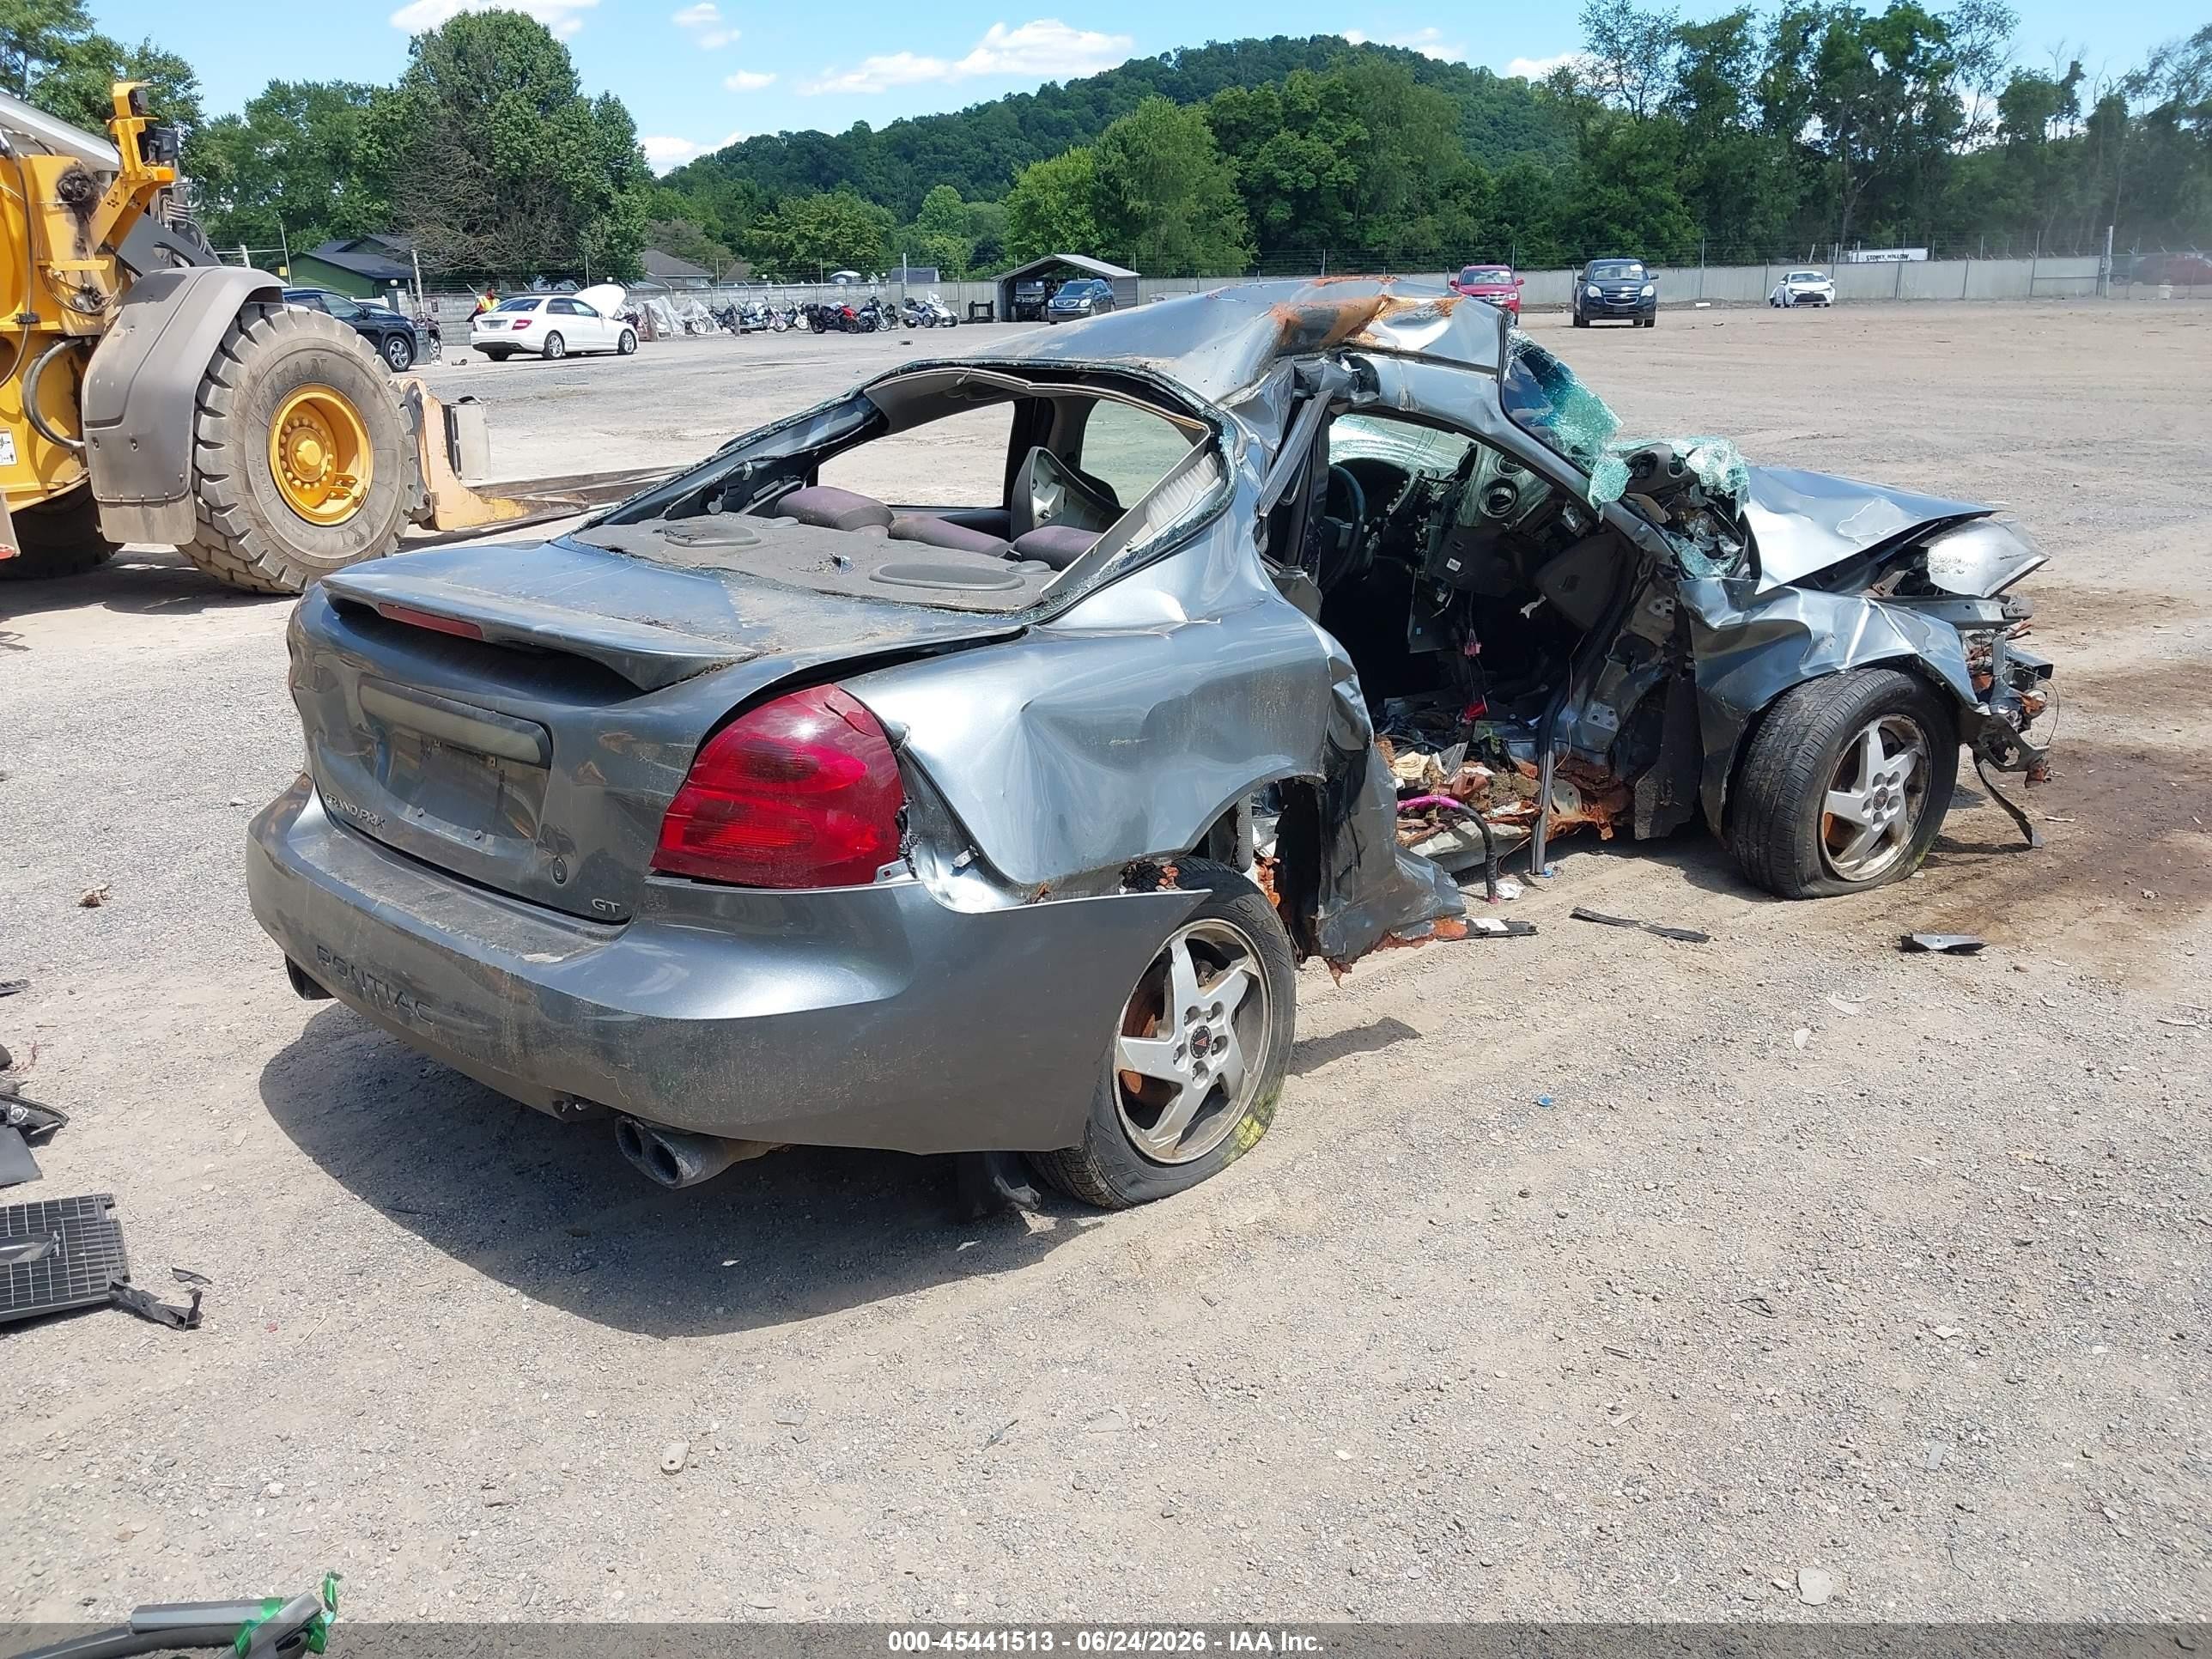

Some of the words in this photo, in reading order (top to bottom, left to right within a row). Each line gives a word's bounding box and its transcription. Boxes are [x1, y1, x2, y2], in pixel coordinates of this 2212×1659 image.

[325, 793, 358, 817] GRAND
[359, 809, 386, 830] PRIX
[592, 898, 621, 913] GT
[316, 944, 434, 1025] PONTIAC
